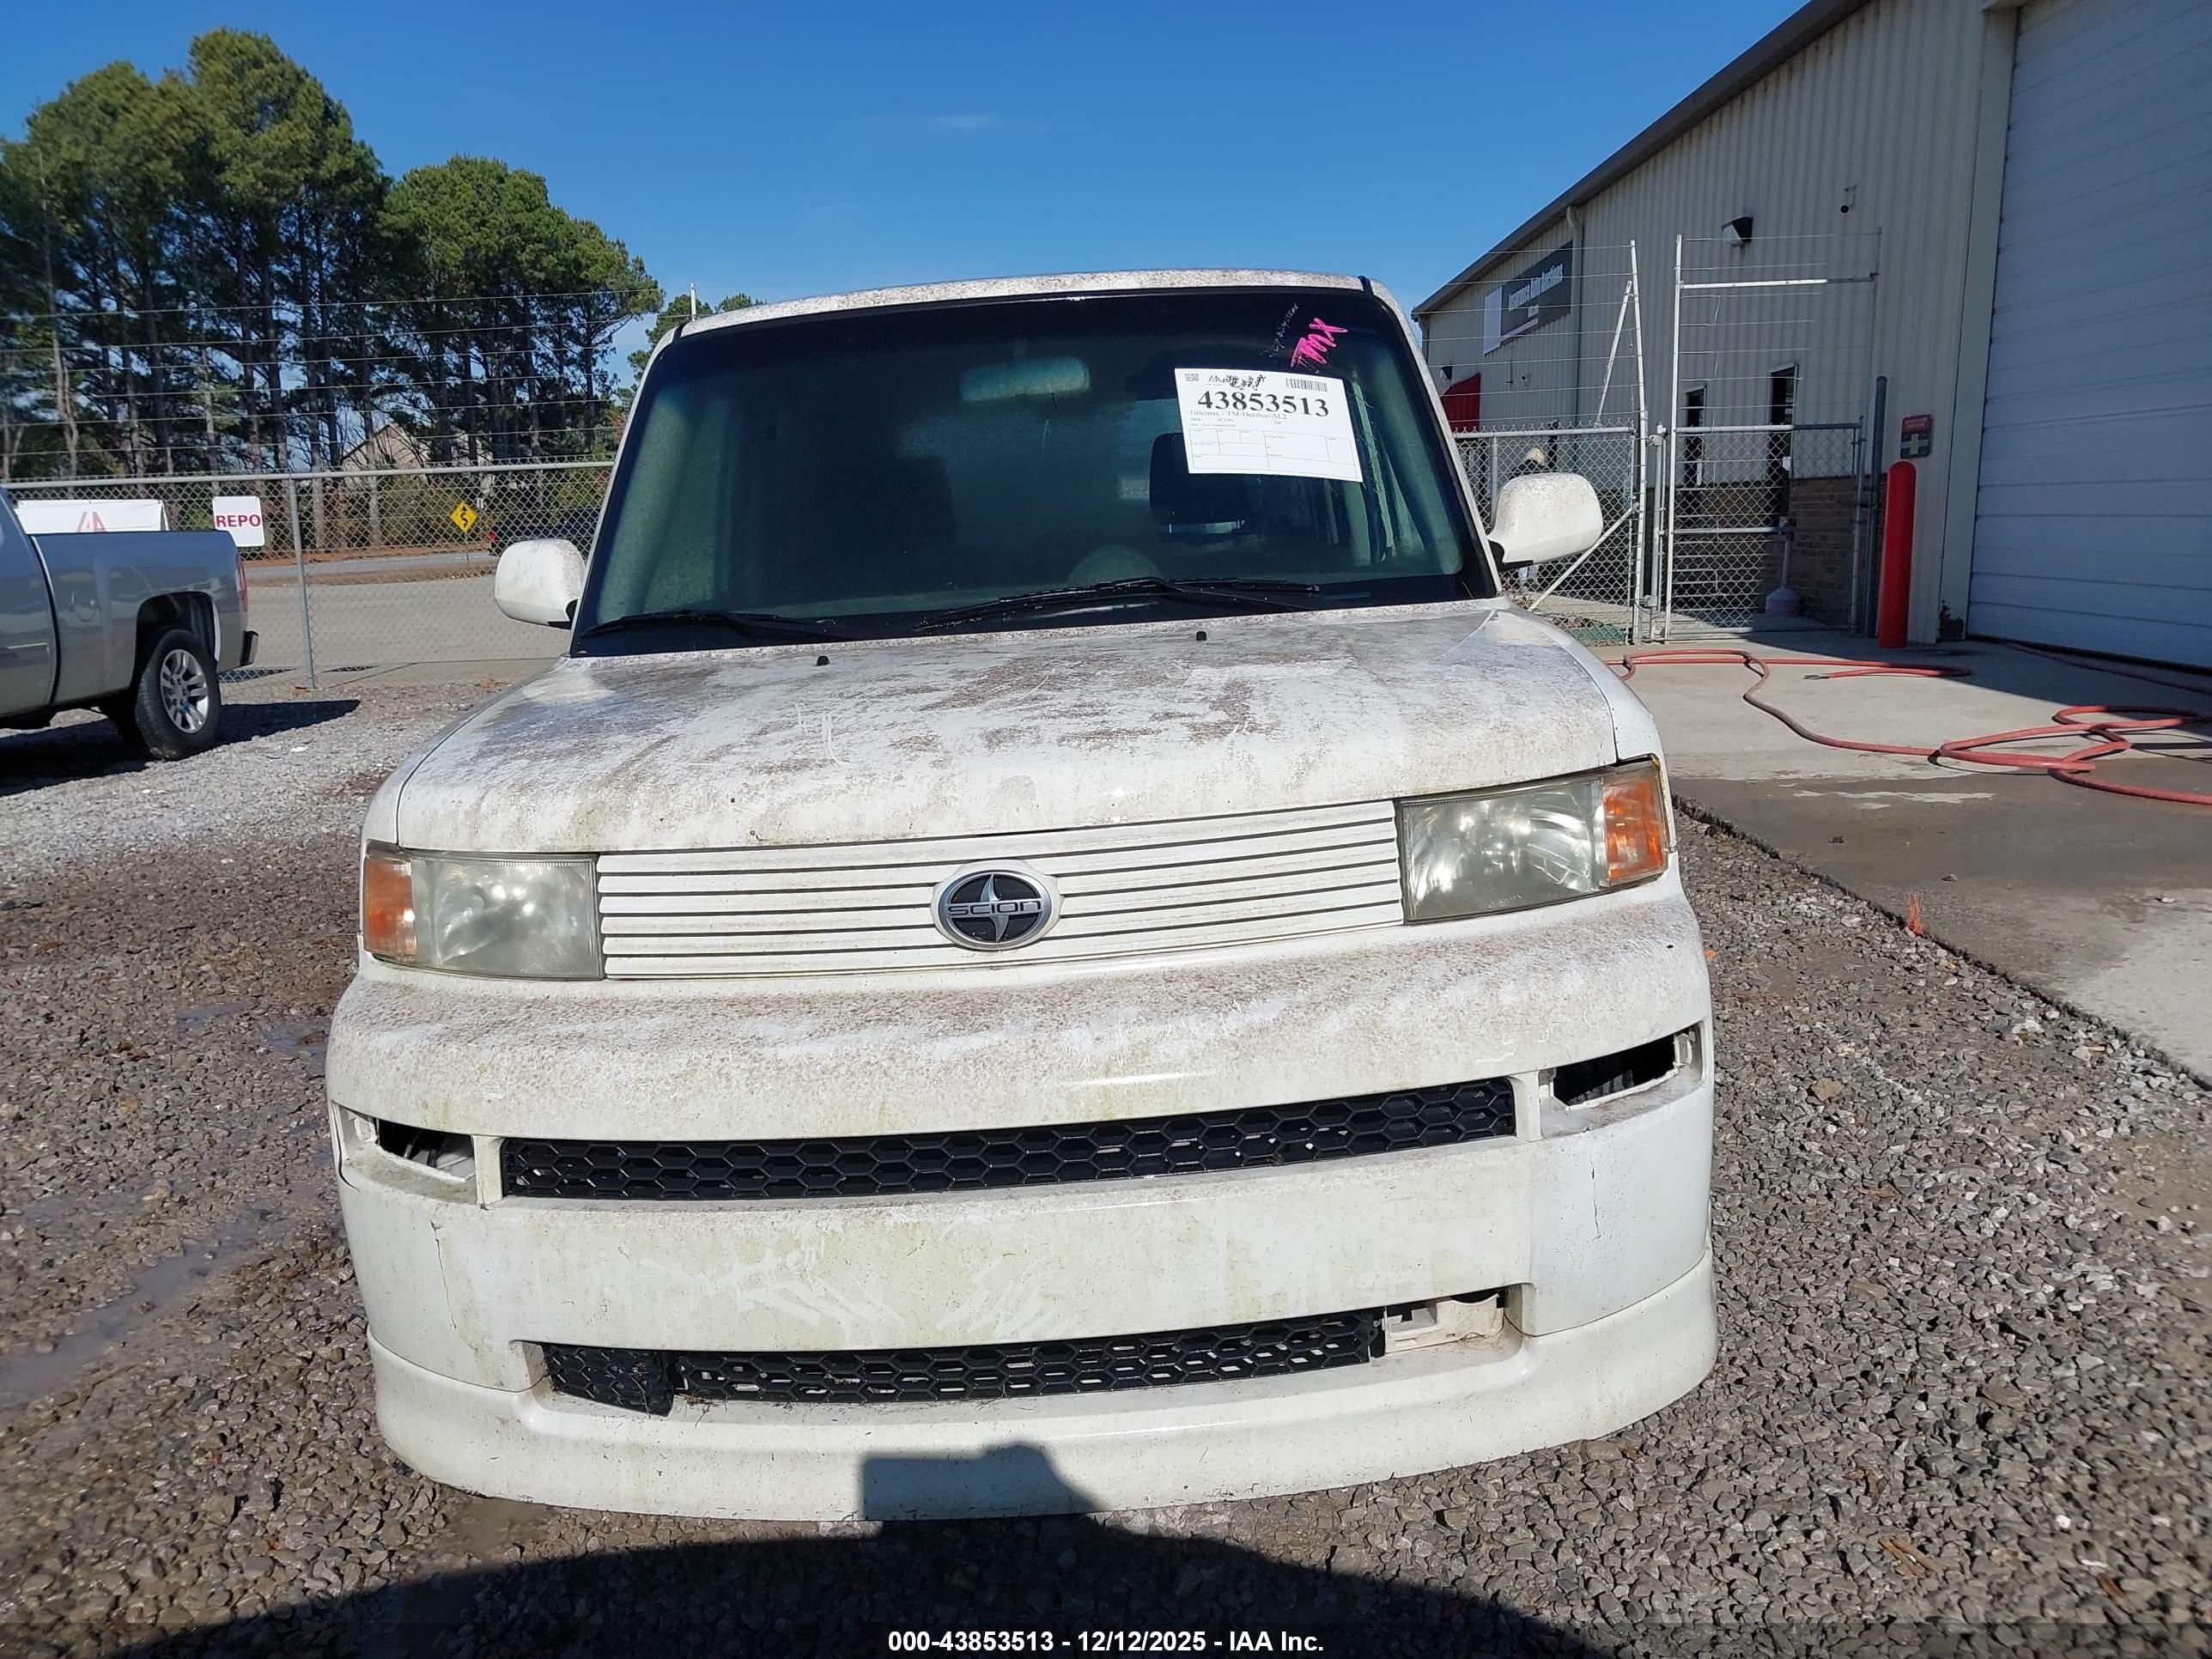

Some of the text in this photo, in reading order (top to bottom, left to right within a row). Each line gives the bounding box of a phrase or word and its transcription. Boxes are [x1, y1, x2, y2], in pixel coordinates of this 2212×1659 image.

[1198, 390, 1329, 418] 43853513
[216, 514, 261, 528] REPO
[947, 900, 1042, 916] SCION
